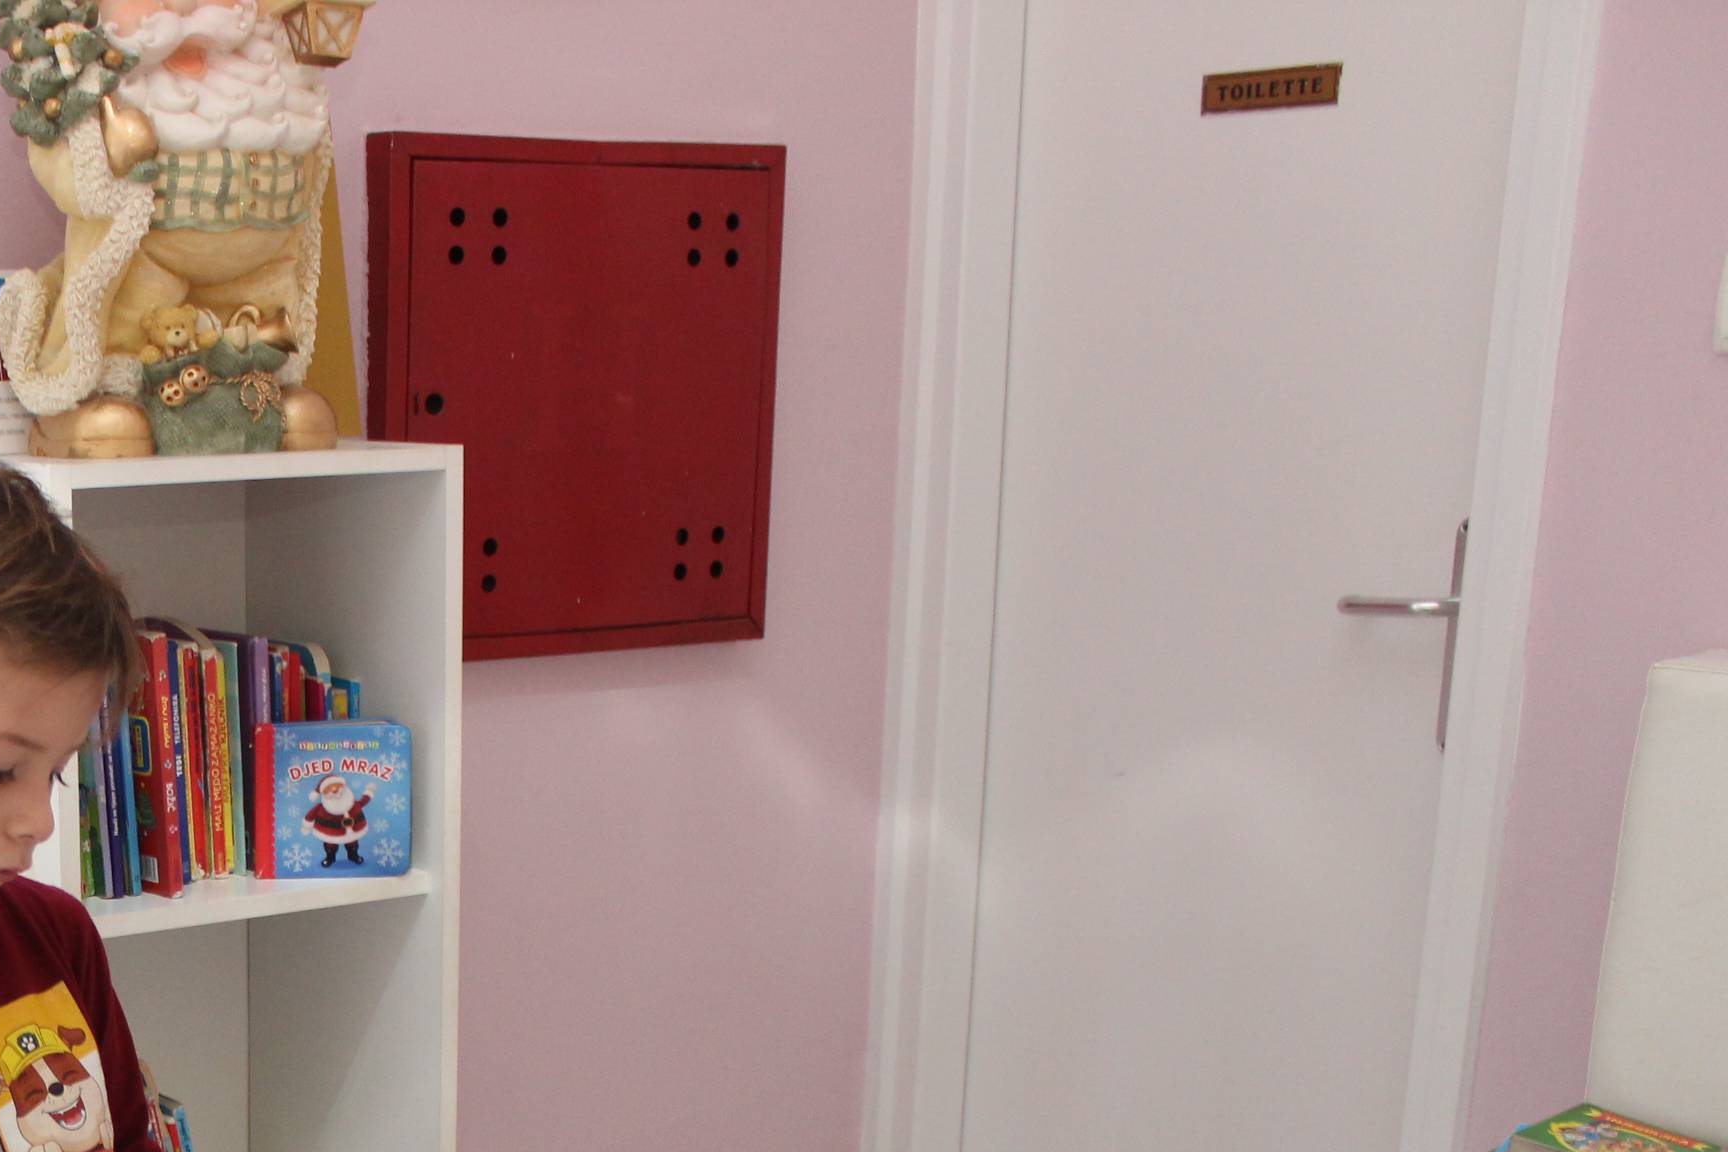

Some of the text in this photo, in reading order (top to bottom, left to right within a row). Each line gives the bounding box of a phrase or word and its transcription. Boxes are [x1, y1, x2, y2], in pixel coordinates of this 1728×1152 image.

[1218, 76, 1323, 101] TOILETTE
[207, 692, 223, 832] MALI MEDO ZAMAZANKO
[289, 758, 393, 783] DJED MRAZ
[165, 783, 176, 813] BOŽIĆ
